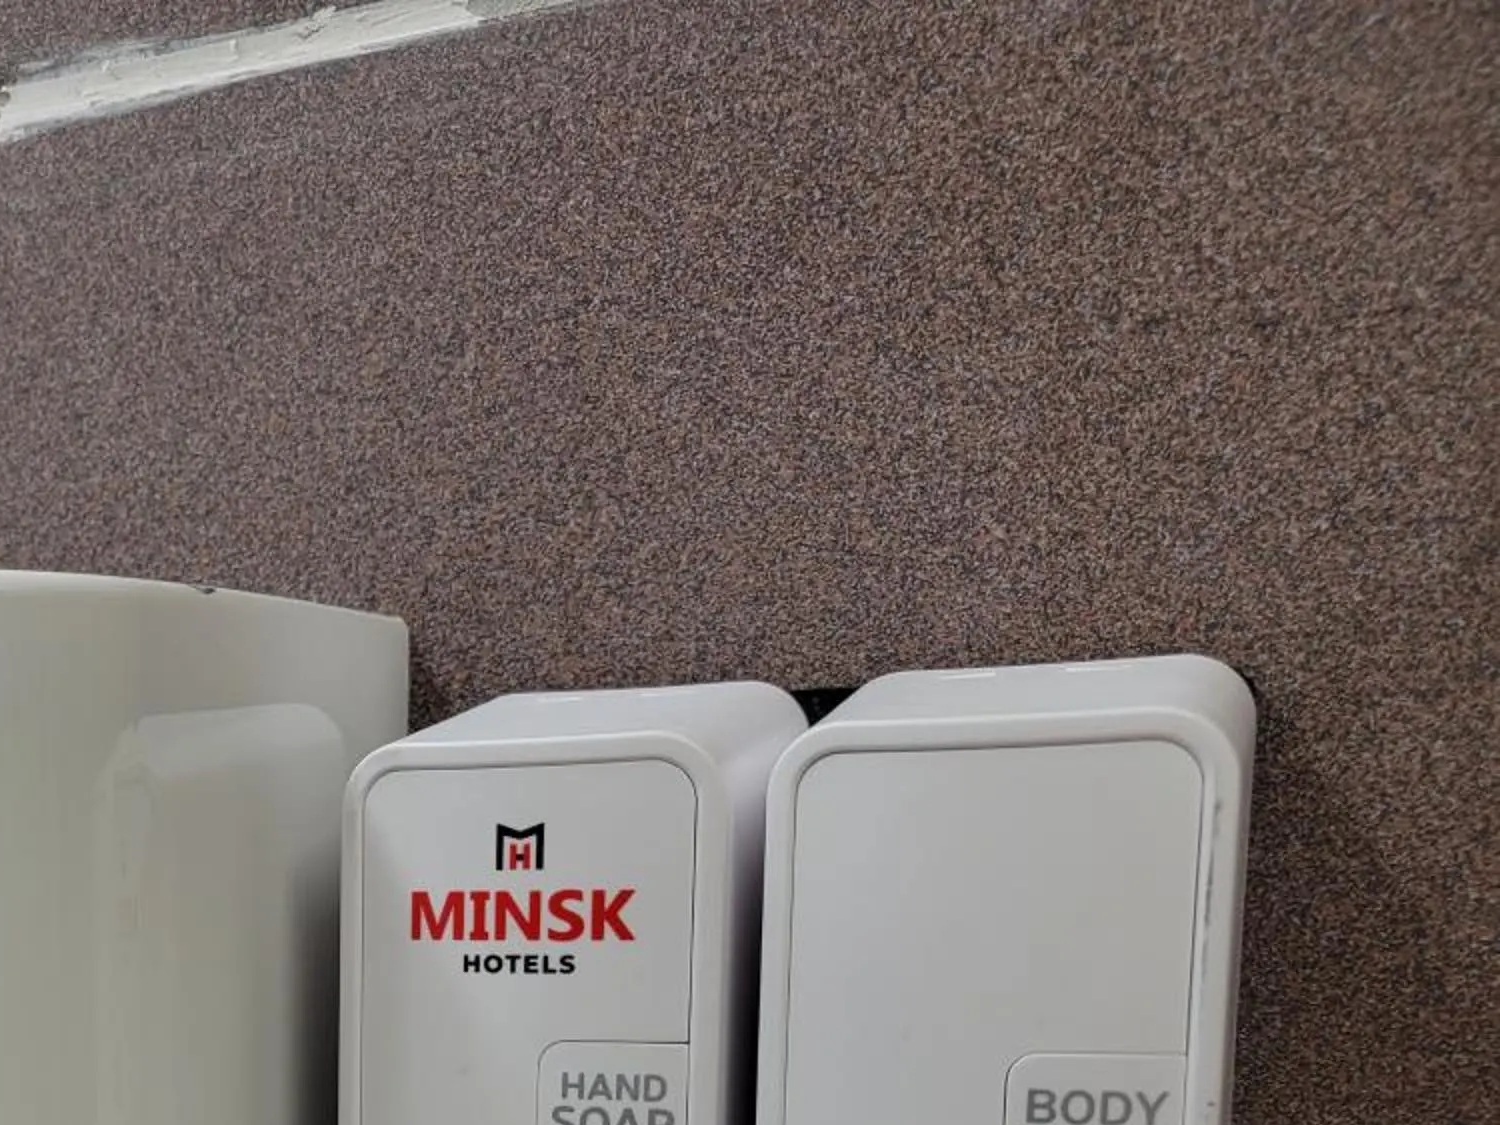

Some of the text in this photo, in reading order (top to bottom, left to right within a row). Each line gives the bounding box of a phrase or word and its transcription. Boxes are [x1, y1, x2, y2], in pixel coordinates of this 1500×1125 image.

[410, 888, 636, 942] MINSK
[463, 954, 576, 975] HOTELS
[561, 1072, 668, 1103] HAND
